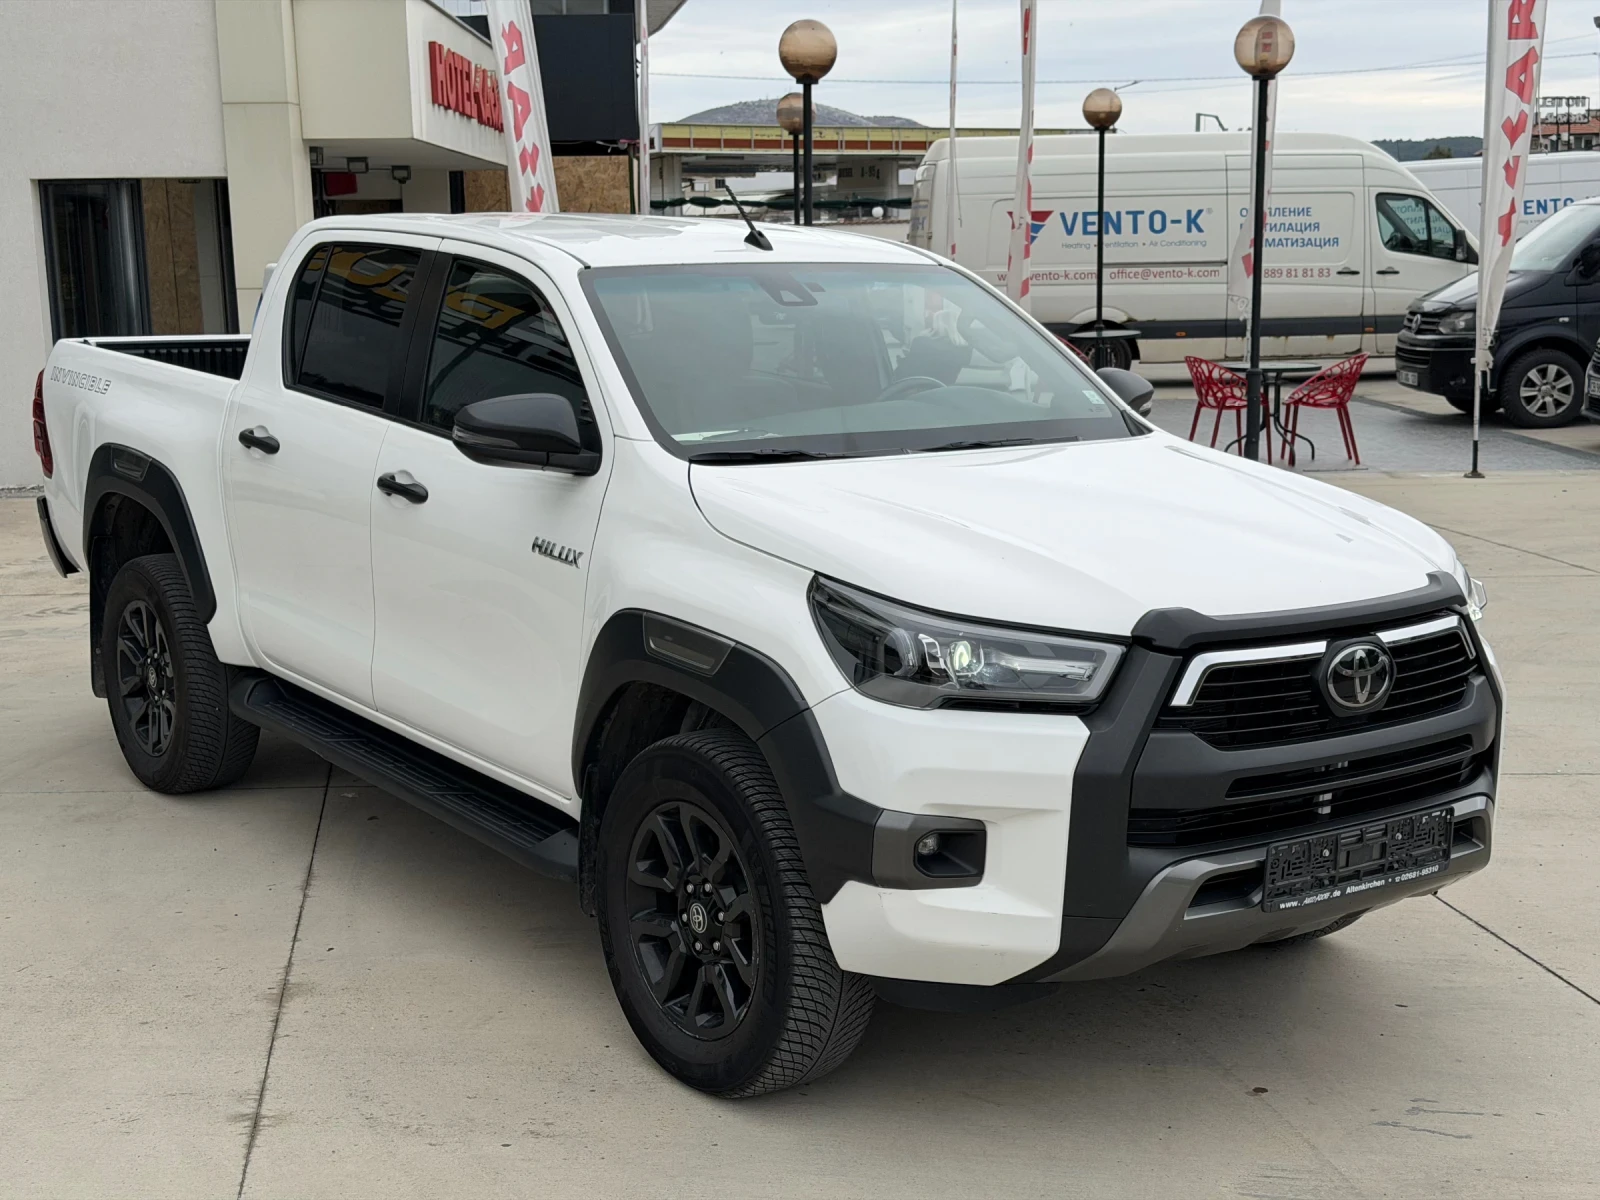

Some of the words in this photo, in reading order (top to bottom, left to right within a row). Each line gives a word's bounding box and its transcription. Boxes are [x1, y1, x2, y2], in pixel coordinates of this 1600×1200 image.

[428, 41, 477, 120] HOTEL
[1523, 197, 1575, 216] ENT
[1059, 209, 1205, 237] VENTO-K
[1061, 242, 1091, 250] Heating
[1160, 239, 1207, 248] Conditioning
[1263, 237, 1339, 249] МАТИЗАЦИЯ
[997, 270, 1098, 281] wvento-k.com
[1109, 268, 1220, 280] office@vento-k.com
[1286, 268, 1299, 278] 81
[1302, 268, 1315, 278] 81
[1317, 268, 1331, 278] 83
[50, 365, 112, 395] INVINCIBLE
[531, 535, 584, 569] HILUX
[1345, 879, 1386, 895] Altenkirchen
